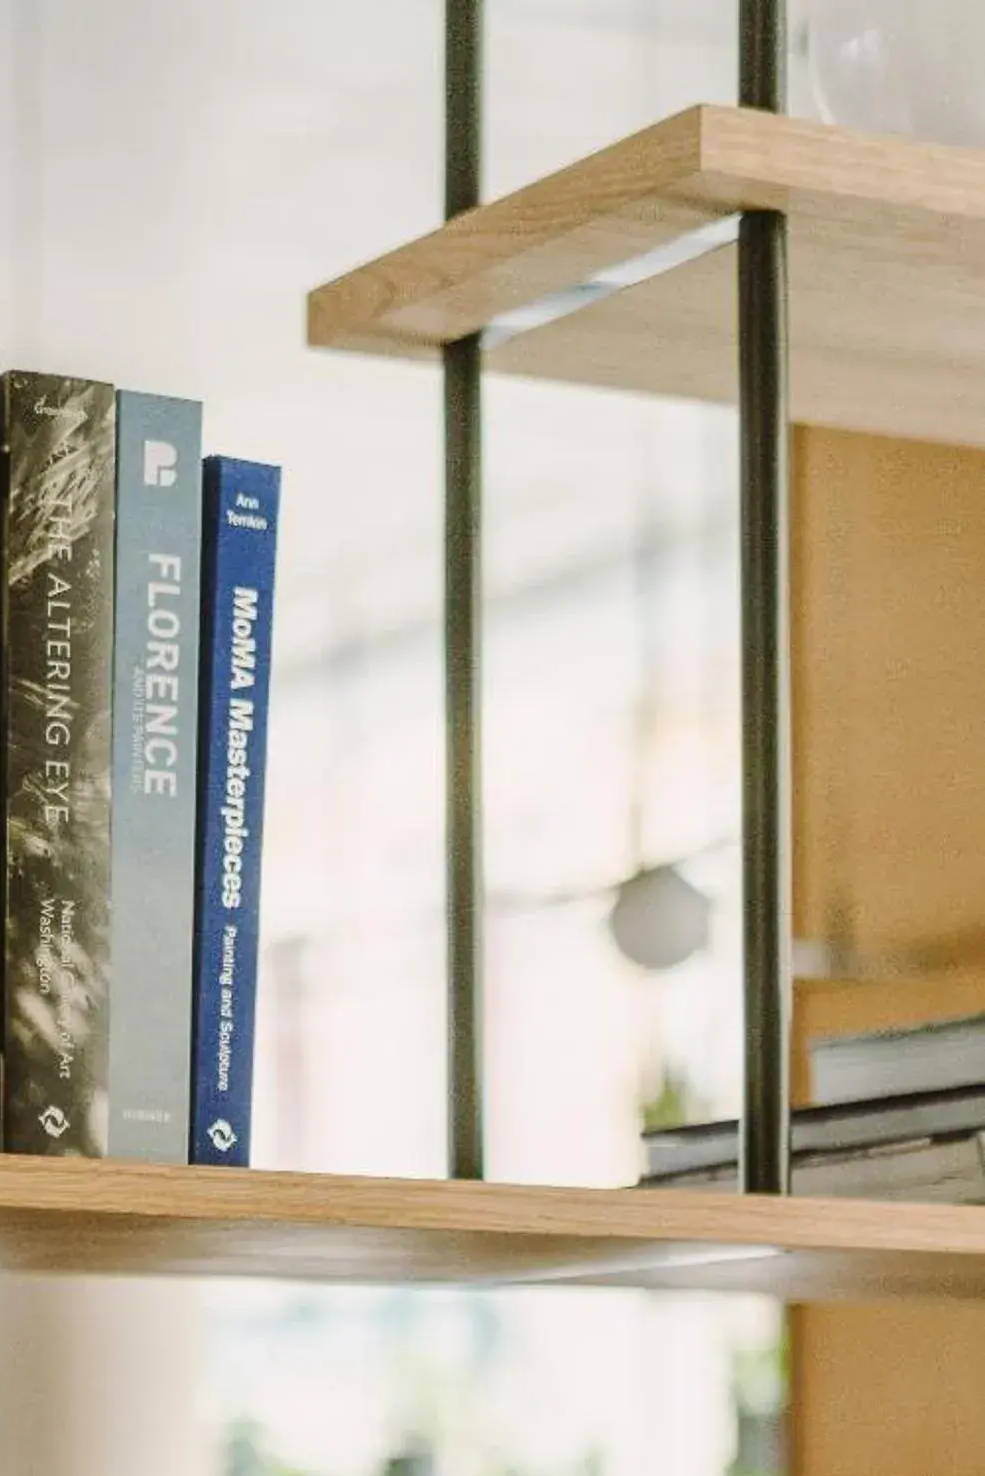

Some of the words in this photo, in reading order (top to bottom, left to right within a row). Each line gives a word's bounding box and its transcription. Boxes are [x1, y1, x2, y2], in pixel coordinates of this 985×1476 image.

[46, 499, 73, 563] THE
[235, 493, 259, 509] Ann
[45, 574, 72, 748] ALTERING
[229, 586, 258, 690] MoMA
[144, 552, 182, 797] FLORENCE
[43, 759, 70, 824] EYE
[221, 698, 255, 909] Masterpieces
[37, 898, 56, 993] Washington
[60, 899, 77, 968] National
[219, 925, 238, 986] Painting
[220, 989, 234, 1018] and
[59, 1052, 75, 1079] Art
[216, 1021, 235, 1092] Sculpture
